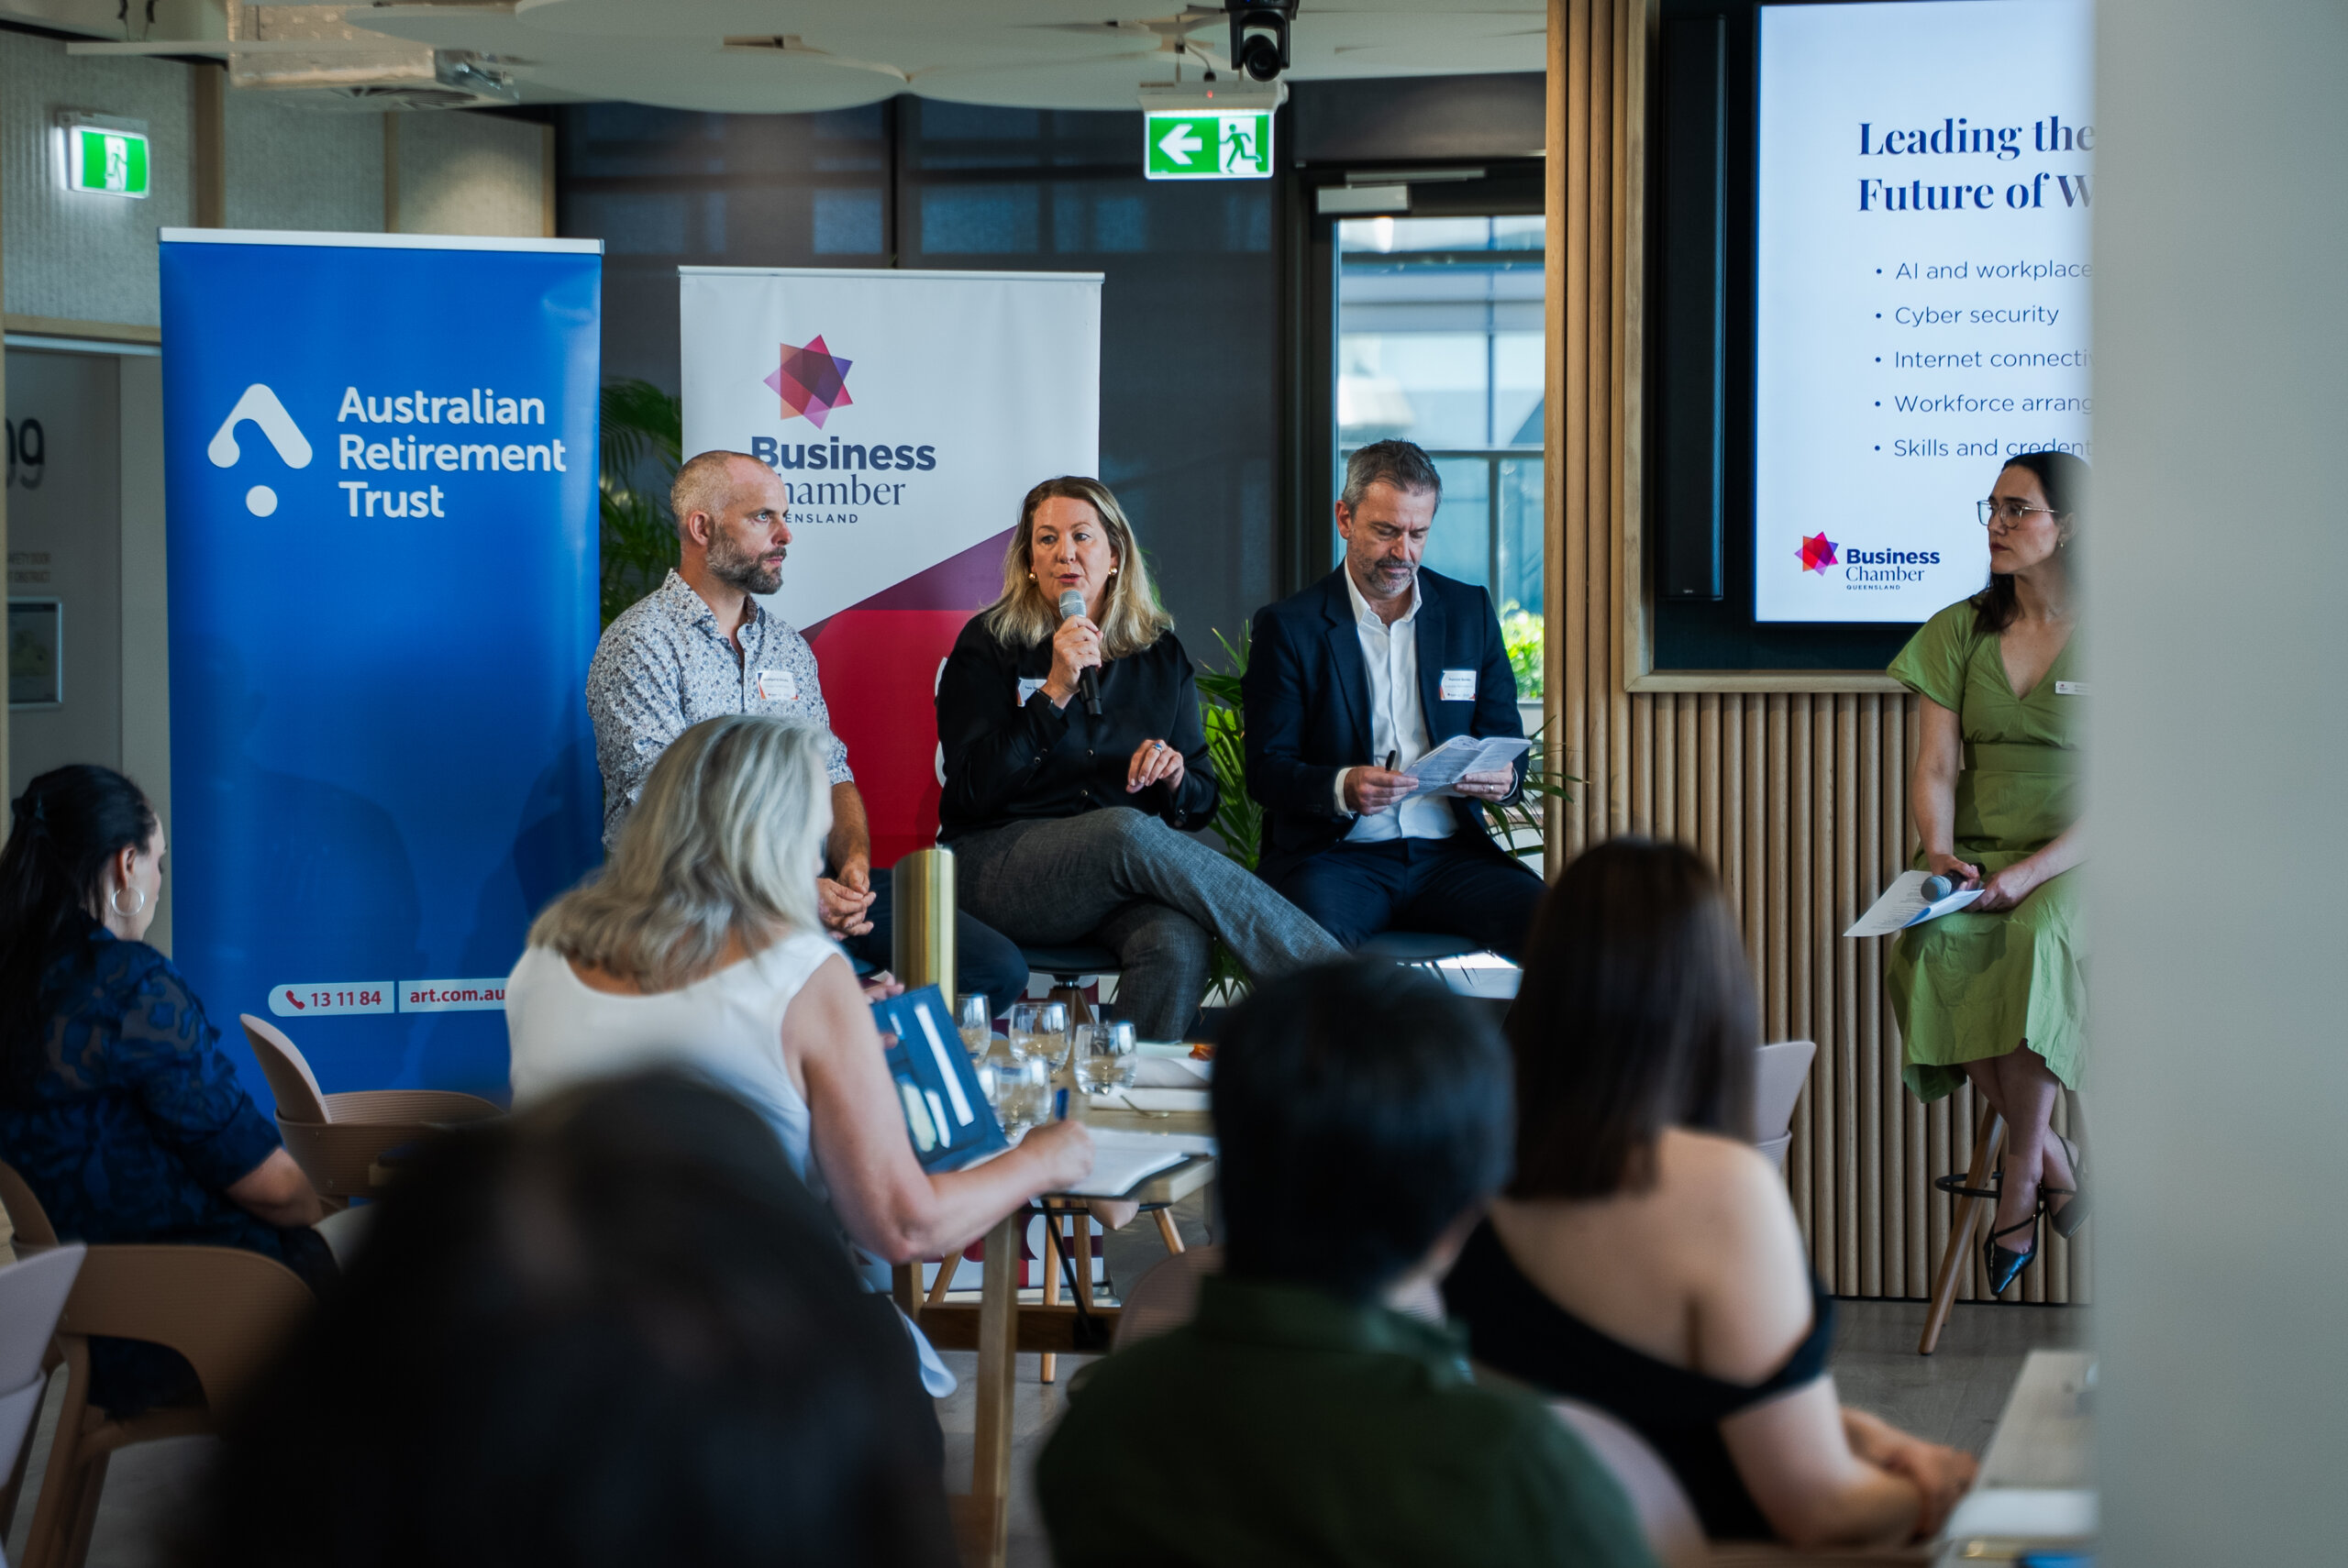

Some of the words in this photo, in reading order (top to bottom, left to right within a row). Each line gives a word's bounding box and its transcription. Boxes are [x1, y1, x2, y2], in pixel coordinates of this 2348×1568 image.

[1857, 117, 2023, 161] Leading
[2031, 115, 2096, 152] the
[1857, 178, 1995, 212] Future
[2005, 171, 2051, 210] of
[1895, 261, 1919, 281] AI
[1926, 260, 1968, 280] and
[1976, 259, 2094, 282] workplace
[1895, 305, 1963, 328] Cyber
[1969, 304, 2060, 326] security
[1895, 351, 1983, 369] Internet
[337, 386, 546, 425] Australian
[1894, 394, 2015, 413] Workforce
[338, 434, 568, 472] Retirement
[751, 436, 937, 471] Business
[1894, 438, 1949, 457] Skills
[1956, 438, 1999, 457] and
[338, 480, 446, 518] Trust
[777, 473, 906, 506] hamber
[784, 513, 858, 525] ENSLAND
[1846, 547, 1941, 565] Business
[1845, 566, 1925, 582] Chamber
[311, 992, 331, 1008] 13
[337, 991, 355, 1007] 11
[359, 990, 382, 1006] 84
[409, 988, 506, 1004] art.com.au
